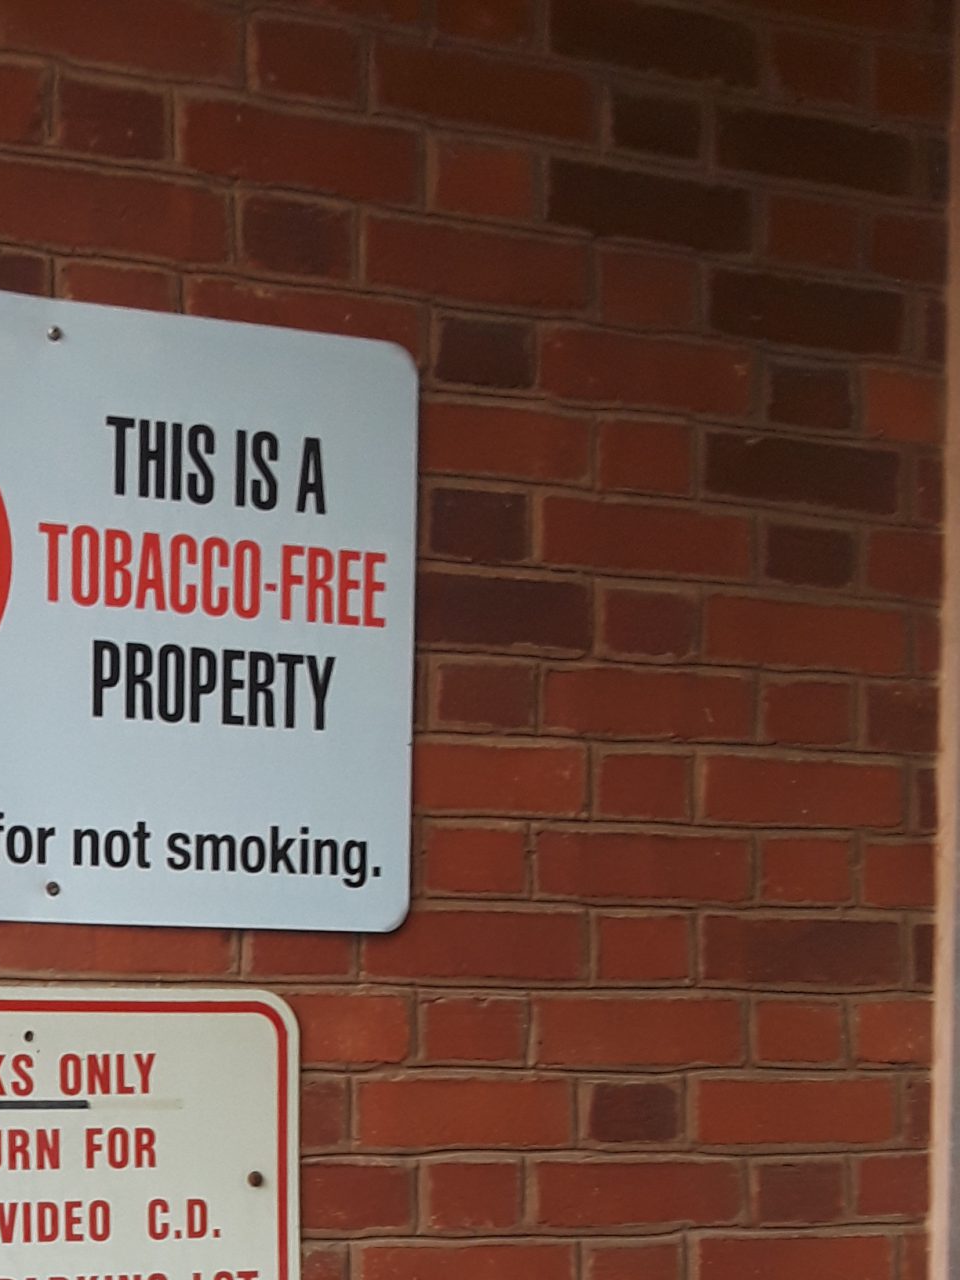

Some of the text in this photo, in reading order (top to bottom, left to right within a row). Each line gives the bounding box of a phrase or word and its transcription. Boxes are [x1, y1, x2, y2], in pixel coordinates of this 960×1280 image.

[106, 416, 327, 515] THIS IS A
[39, 522, 387, 628] TOBACCO-FREE
[91, 639, 336, 731] PROPERTY
[72, 820, 151, 869] not
[166, 825, 382, 889] smoking.
[59, 1052, 156, 1096] ONLY
[85, 1126, 157, 1169] FOR
[147, 1198, 221, 1240] C.D.
